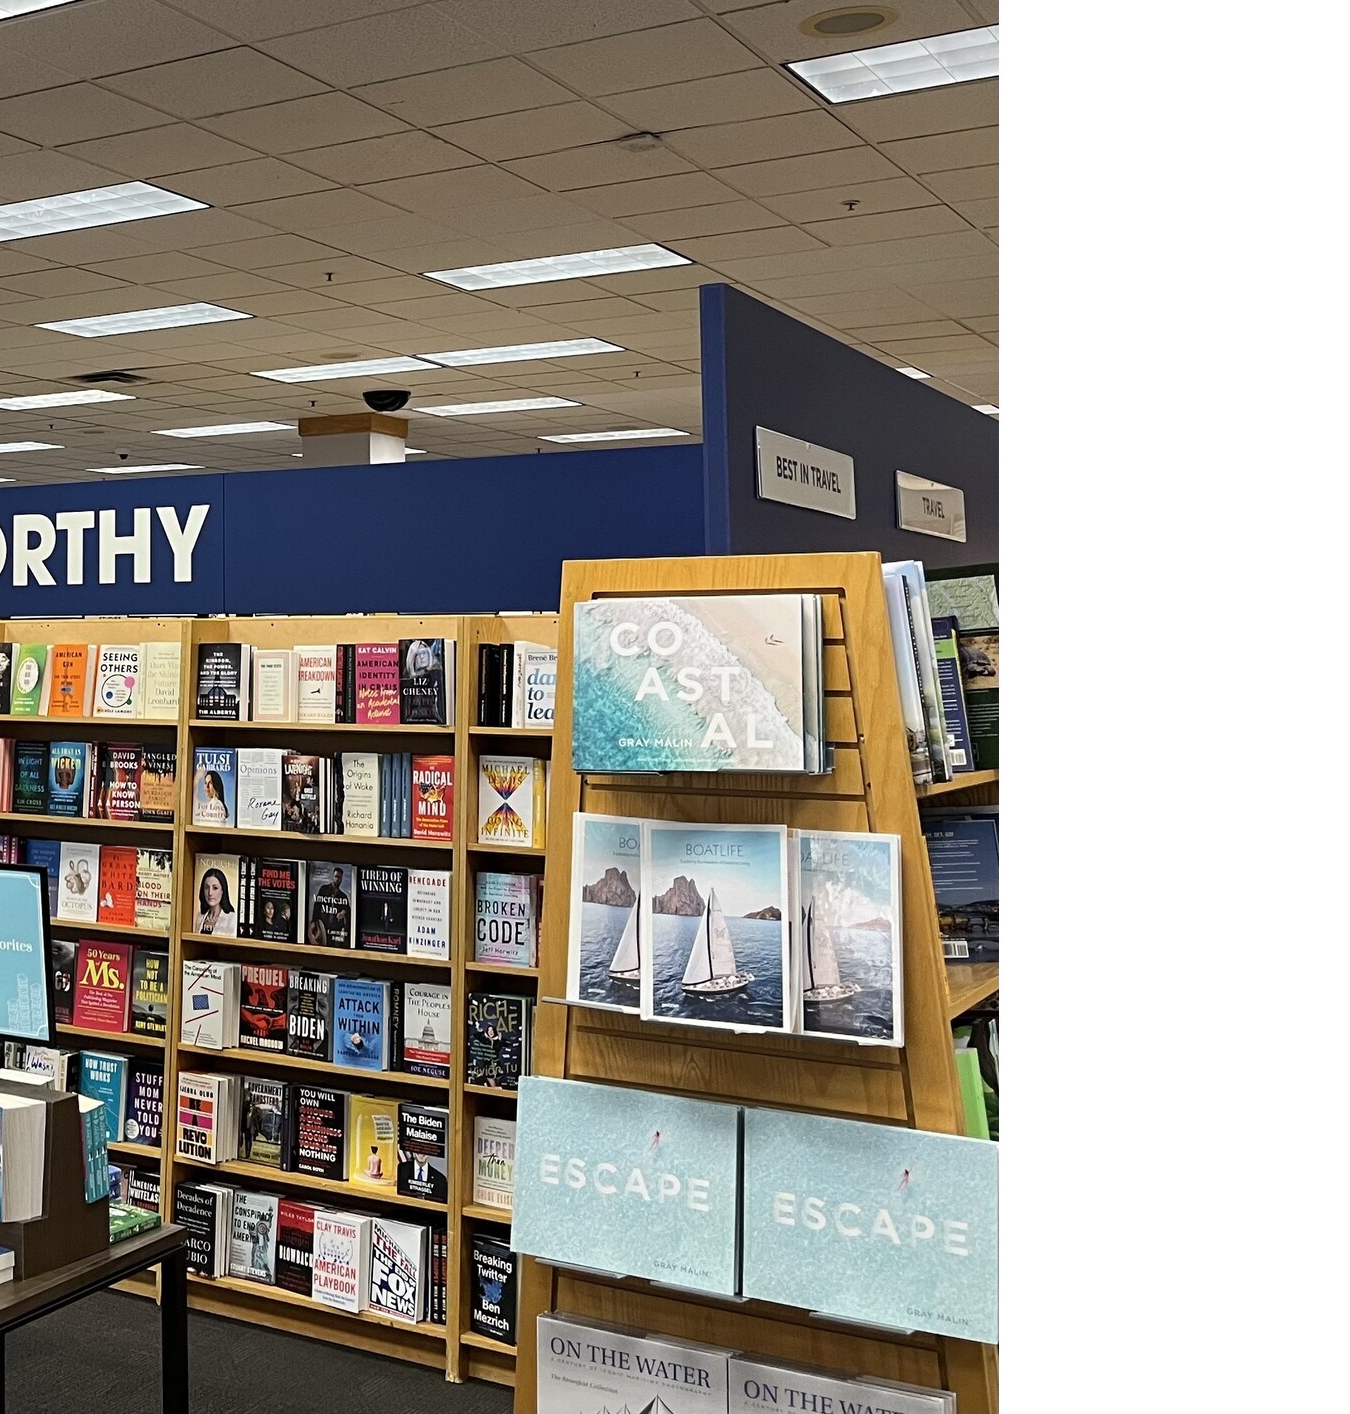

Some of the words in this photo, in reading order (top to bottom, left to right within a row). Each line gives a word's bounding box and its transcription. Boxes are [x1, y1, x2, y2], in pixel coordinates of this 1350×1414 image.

[776, 456, 798, 482] BEST
[800, 462, 809, 484] IN
[811, 466, 841, 494] TRAVEL
[922, 496, 945, 519] TRAVEL
[609, 621, 684, 656] CO
[103, 652, 138, 662] SEEING
[300, 657, 332, 668] AMERICAN
[100, 664, 138, 673] OTHERS
[357, 660, 398, 668] AMERICAN
[413, 677, 428, 686] LIZ
[634, 666, 740, 702] AST
[155, 688, 175, 696] David
[403, 687, 439, 696] CHENEY
[527, 688, 544, 701] to
[700, 712, 774, 749] AL
[618, 738, 650, 748] GRAY
[654, 738, 693, 748] MALIN
[112, 752, 136, 760] DAVID
[197, 753, 230, 765] TULSI
[110, 761, 138, 769] BROOKS
[240, 763, 278, 776] Opinions
[353, 759, 365, 768] The
[481, 764, 530, 775] MICHAEL
[347, 770, 372, 780] Origins
[413, 770, 453, 786] RADICAL
[109, 781, 125, 789] HOW
[127, 782, 137, 790] TO
[346, 782, 353, 790] of
[353, 782, 374, 791] Woke
[111, 791, 135, 799] KNOW
[112, 800, 141, 809] PERSON
[418, 802, 446, 816] MIND
[347, 811, 372, 819] Richard
[345, 820, 374, 830] Hanania
[487, 817, 523, 827] GOING
[481, 828, 529, 838] INFINITE
[686, 844, 743, 857] BOATLIFE
[262, 869, 278, 878] FIND
[280, 870, 290, 879] ME
[360, 869, 388, 881] TIRED
[390, 872, 403, 882] OF
[101, 880, 134, 891] BARD
[258, 878, 271, 886] THE
[272, 879, 295, 889] VOTES
[361, 881, 402, 893] WINNING
[409, 876, 446, 887] RENEGADE
[151, 892, 170, 900] THEIR
[313, 893, 347, 906] American
[61, 901, 93, 910] OCTOPUS
[321, 904, 338, 915] Man
[477, 901, 526, 917] BROKEN
[417, 926, 436, 935] ADAM
[477, 918, 525, 945] CODE
[409, 938, 446, 949] KINZINGER
[87, 948, 98, 958] 50
[99, 950, 120, 961] Years
[79, 959, 125, 990] Ms.
[242, 965, 285, 987] PREQUEL
[289, 975, 327, 994] BREAKING
[409, 987, 436, 998] COURAGE
[437, 992, 449, 1000] IN
[339, 998, 380, 1013] ATTACK
[407, 997, 420, 1006] THE
[469, 1000, 507, 1021] RICH
[289, 1014, 325, 1040] BIDEN
[338, 1016, 380, 1034] WITHIN
[497, 1013, 518, 1034] AF
[135, 1072, 163, 1085] STUFF
[139, 1086, 159, 1099] MOM
[300, 1089, 316, 1098] YOU
[318, 1092, 335, 1102] WILL
[134, 1098, 163, 1112] NEVER
[300, 1098, 319, 1107] OWN
[137, 1111, 160, 1125] TOLD
[402, 1112, 416, 1124] The
[418, 1115, 443, 1128] Biden
[139, 1125, 157, 1138] YOU
[183, 1128, 207, 1144] REVO
[406, 1127, 437, 1141] Malaise
[300, 1149, 336, 1162] NOTHING
[539, 1153, 711, 1213] ESCAPE
[177, 1190, 204, 1205] Decades
[206, 1197, 213, 1206] of
[235, 1194, 247, 1204] THE
[177, 1202, 213, 1218] Decadence
[234, 1219, 242, 1228] TO
[244, 1221, 256, 1231] END
[317, 1221, 332, 1232] CLAY
[334, 1225, 357, 1239] TRAVIS
[771, 1192, 971, 1257] ESCAPE
[474, 1250, 512, 1273] Breaking
[314, 1258, 356, 1280] AMERICAN
[477, 1264, 508, 1283] Twitter
[653, 1260, 678, 1270] GRAY
[680, 1265, 709, 1278] MALIN
[313, 1274, 356, 1296] PLAYBOOK
[372, 1262, 416, 1301] FOX
[372, 1283, 415, 1316] NEWS
[482, 1299, 500, 1314] Ben
[473, 1309, 510, 1331] Mezrich
[906, 1308, 934, 1320] GRAY
[936, 1314, 969, 1327] MALIN
[550, 1337, 581, 1359] ON
[587, 1344, 630, 1371] THE
[635, 1355, 711, 1388] WATER
[744, 1380, 778, 1404] ON
[785, 1388, 833, 1414] THE
